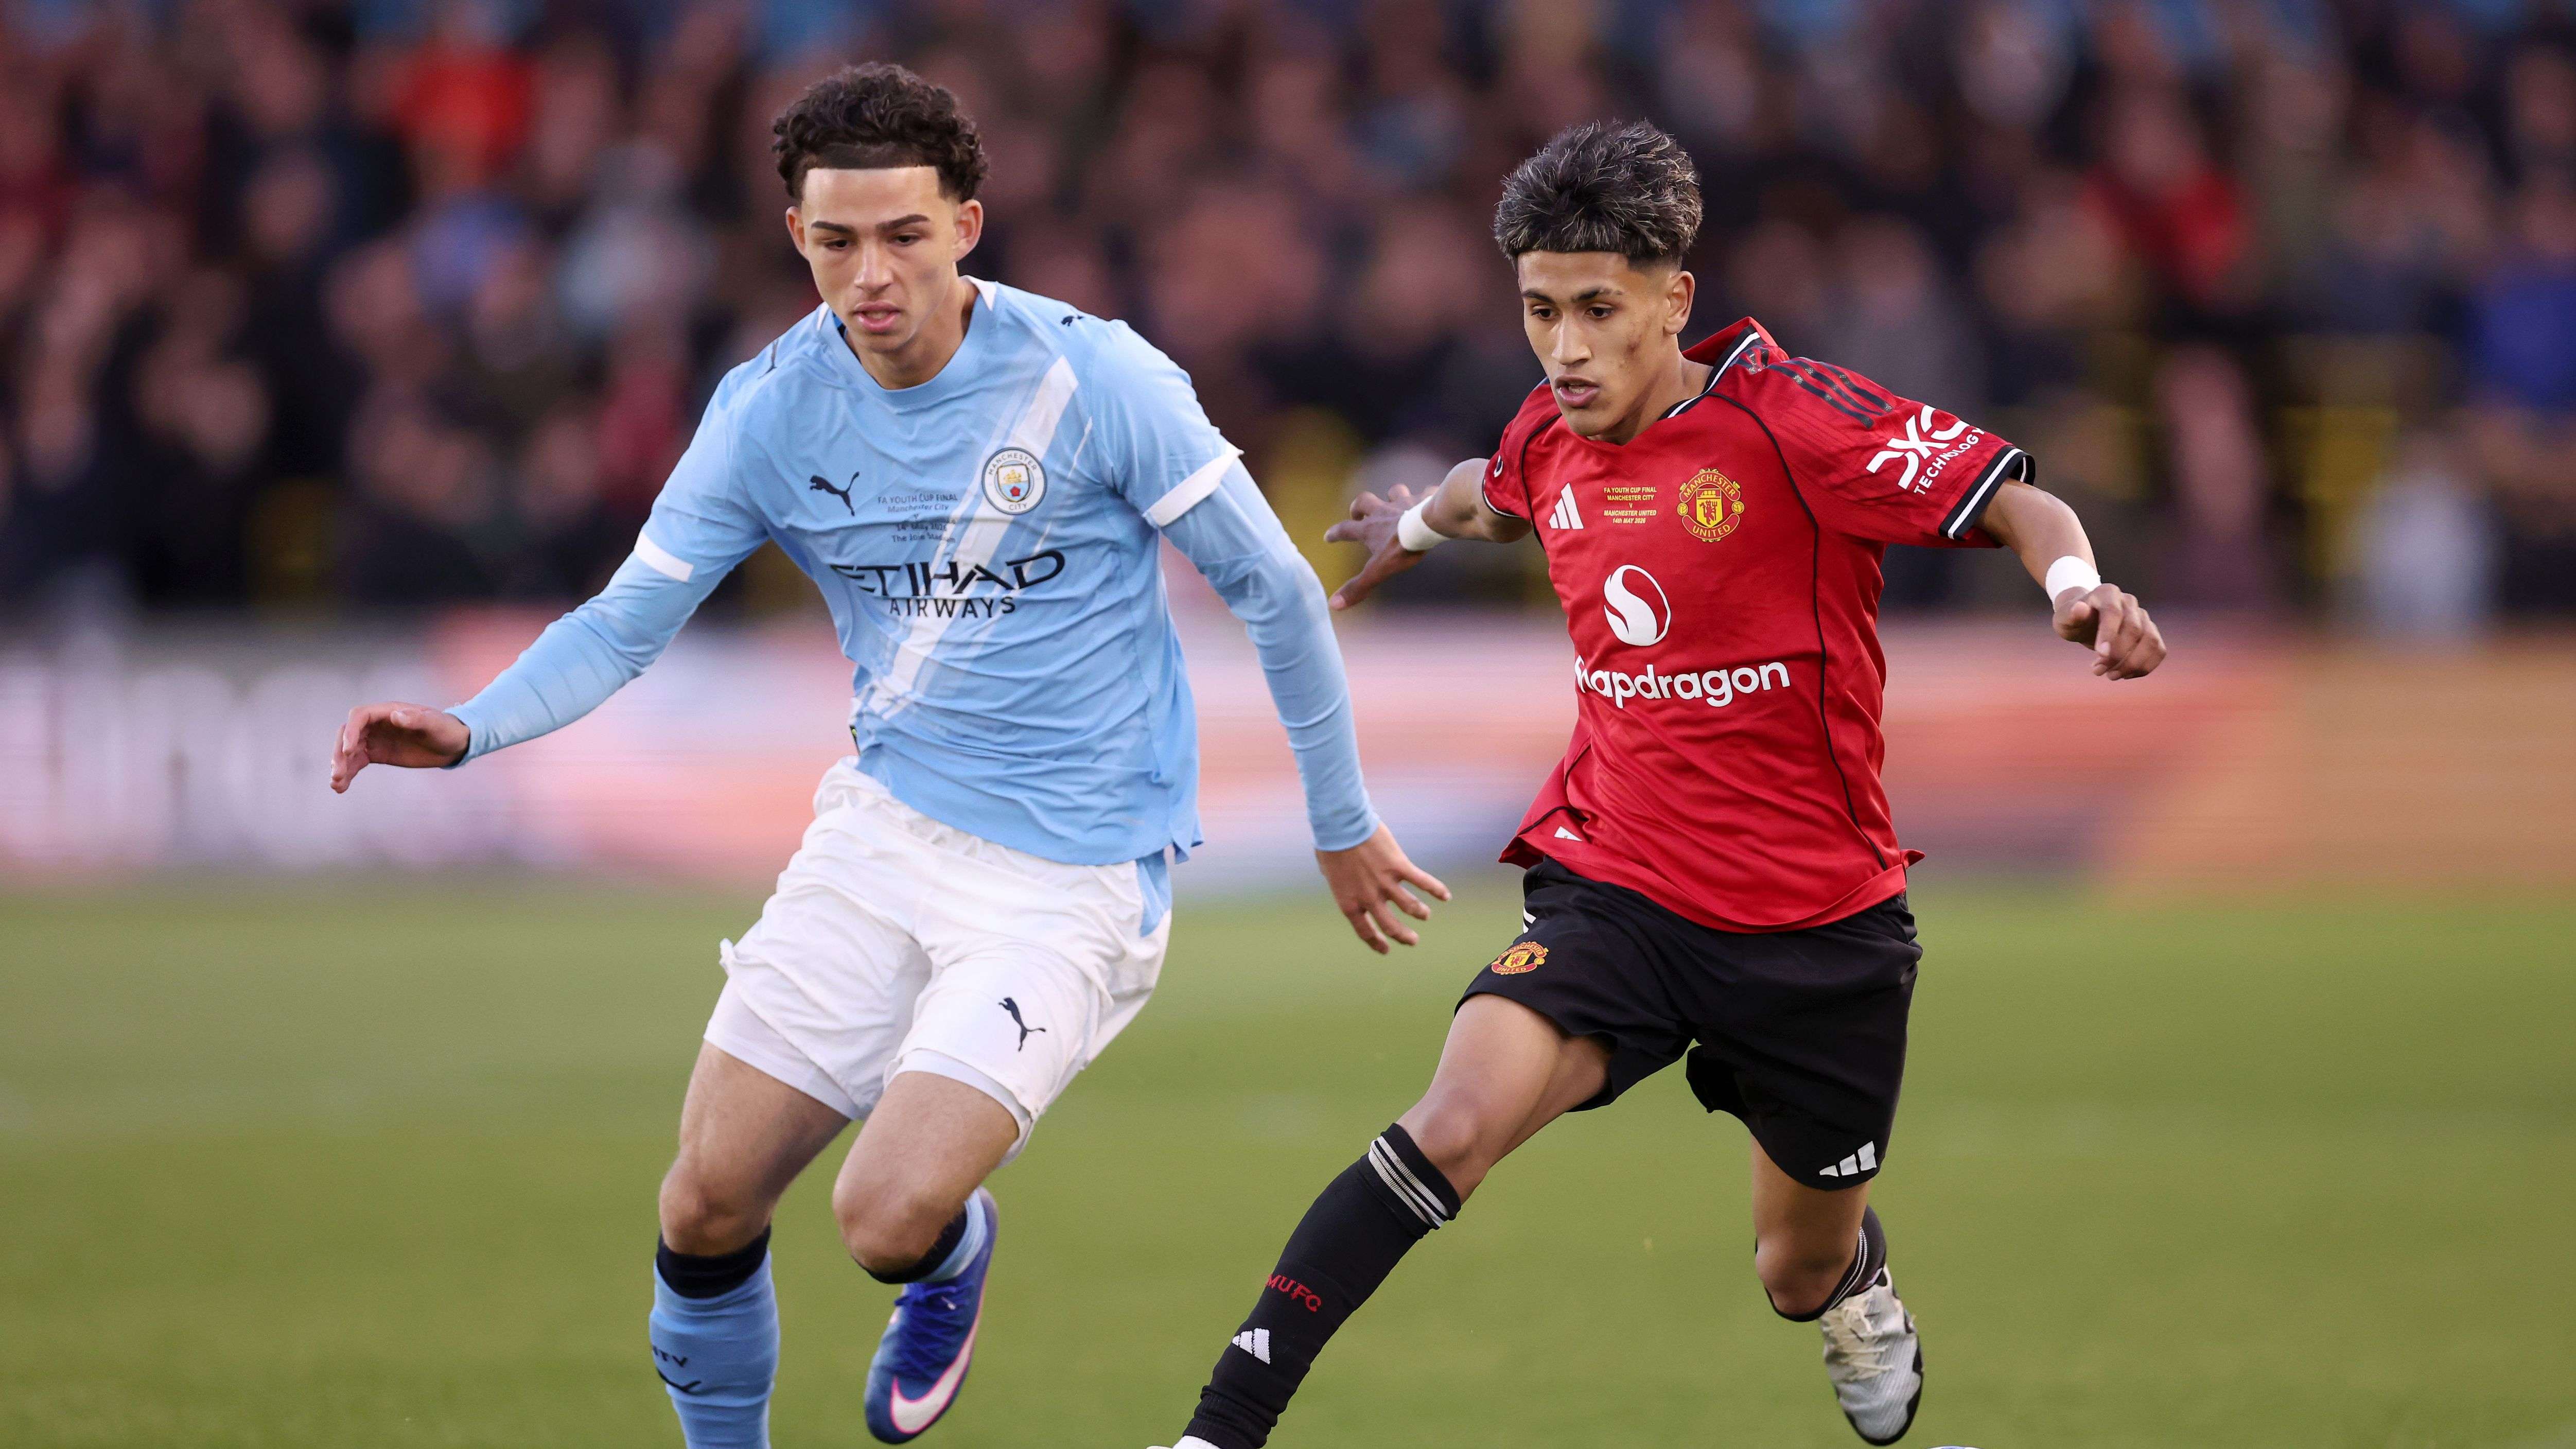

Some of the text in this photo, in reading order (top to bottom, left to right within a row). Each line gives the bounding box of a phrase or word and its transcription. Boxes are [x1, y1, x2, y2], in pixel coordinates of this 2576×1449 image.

[989, 453, 1038, 475] MANCHESTER
[1914, 428, 1985, 495] TECHNOLOGY
[1683, 474, 1736, 498] MANCHESTER
[887, 503, 950, 513] Manchester City
[889, 495, 917, 504] YOUTH
[919, 493, 934, 501] CUP
[936, 493, 958, 501] FINAL
[1692, 524, 1730, 537] UNITED
[830, 549, 1065, 596] ETIHAD
[890, 596, 1016, 619] AIRWAYS
[1266, 1273, 1322, 1312] MUFC
